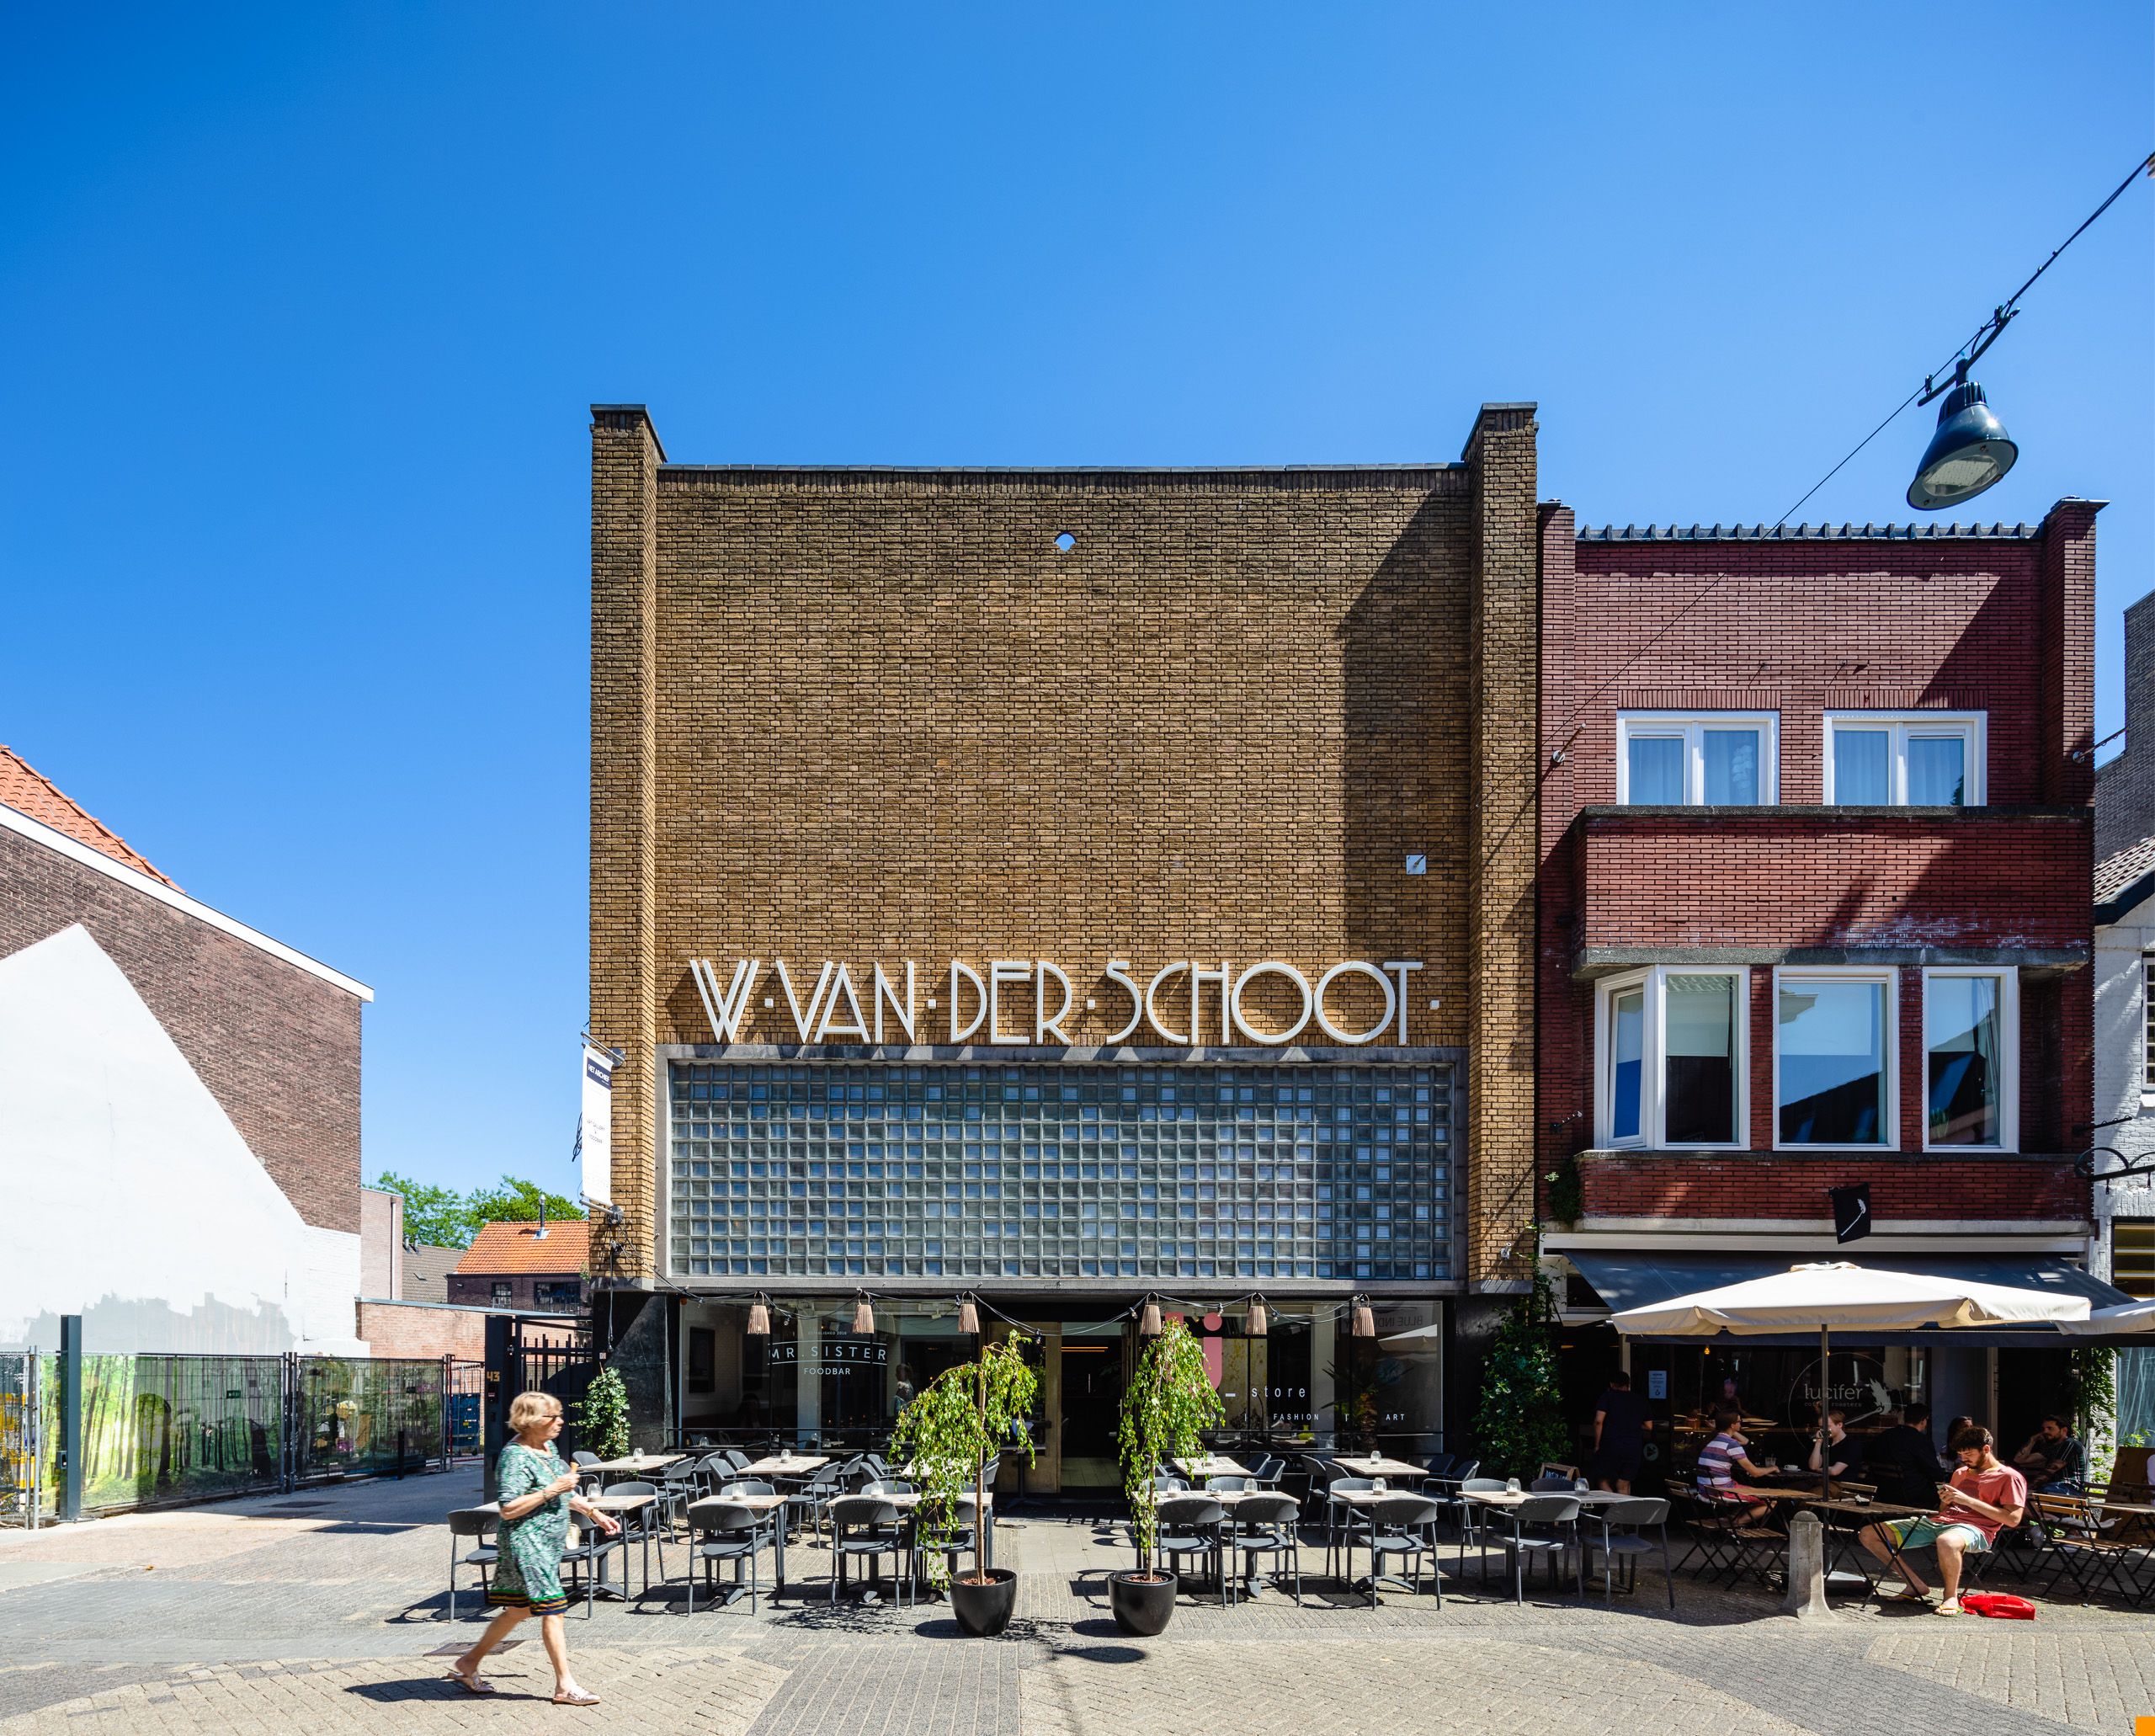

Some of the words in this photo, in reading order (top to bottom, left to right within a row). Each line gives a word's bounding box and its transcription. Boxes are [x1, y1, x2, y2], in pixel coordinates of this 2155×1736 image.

[811, 1346, 886, 1360] SISTER
[487, 1371, 500, 1382] 43
[803, 1367, 851, 1376] FOODBAR
[1273, 1413, 1319, 1421] FASHION
[1386, 1413, 1406, 1421] ART
